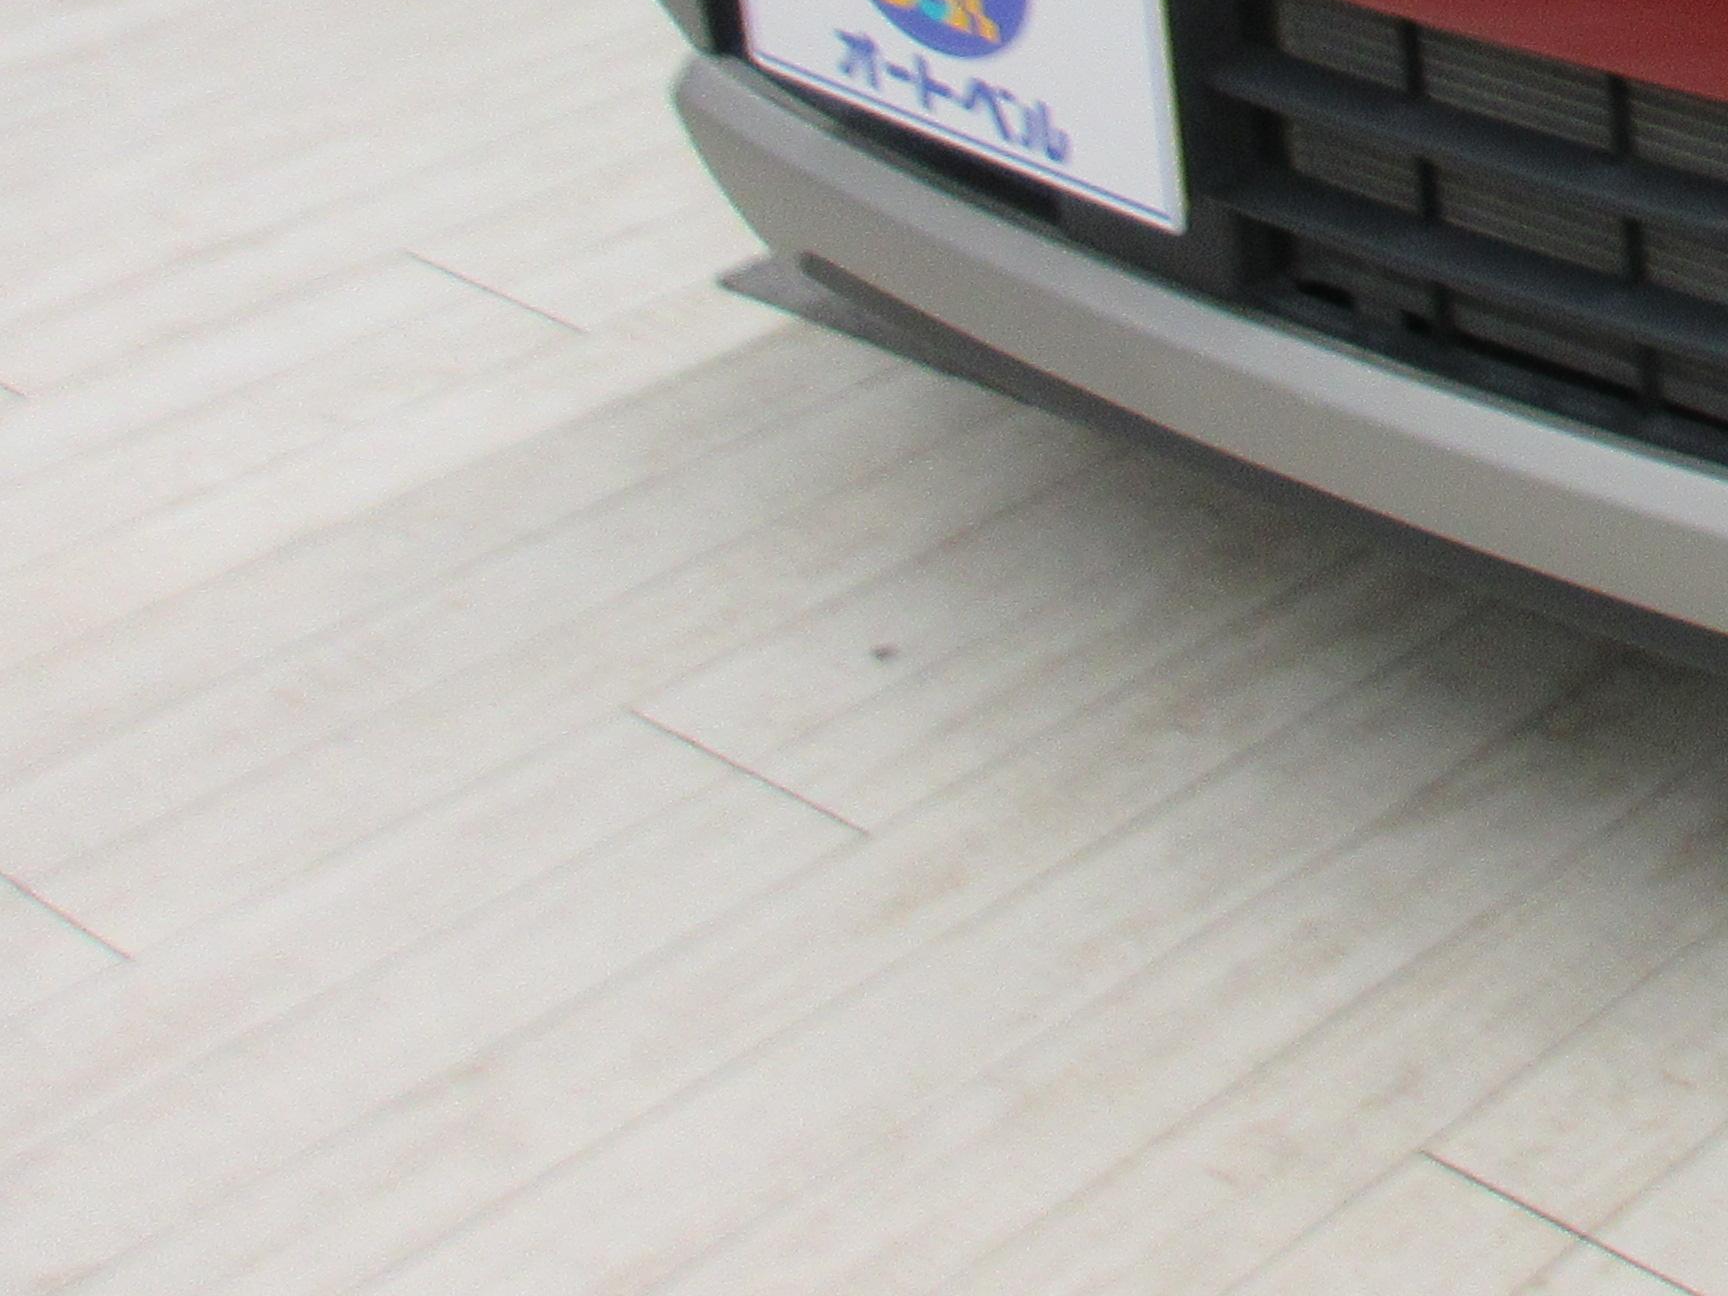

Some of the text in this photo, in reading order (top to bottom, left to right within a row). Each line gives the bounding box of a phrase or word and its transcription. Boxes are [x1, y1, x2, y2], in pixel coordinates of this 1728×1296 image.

[833, 28, 1072, 165] オートベル
